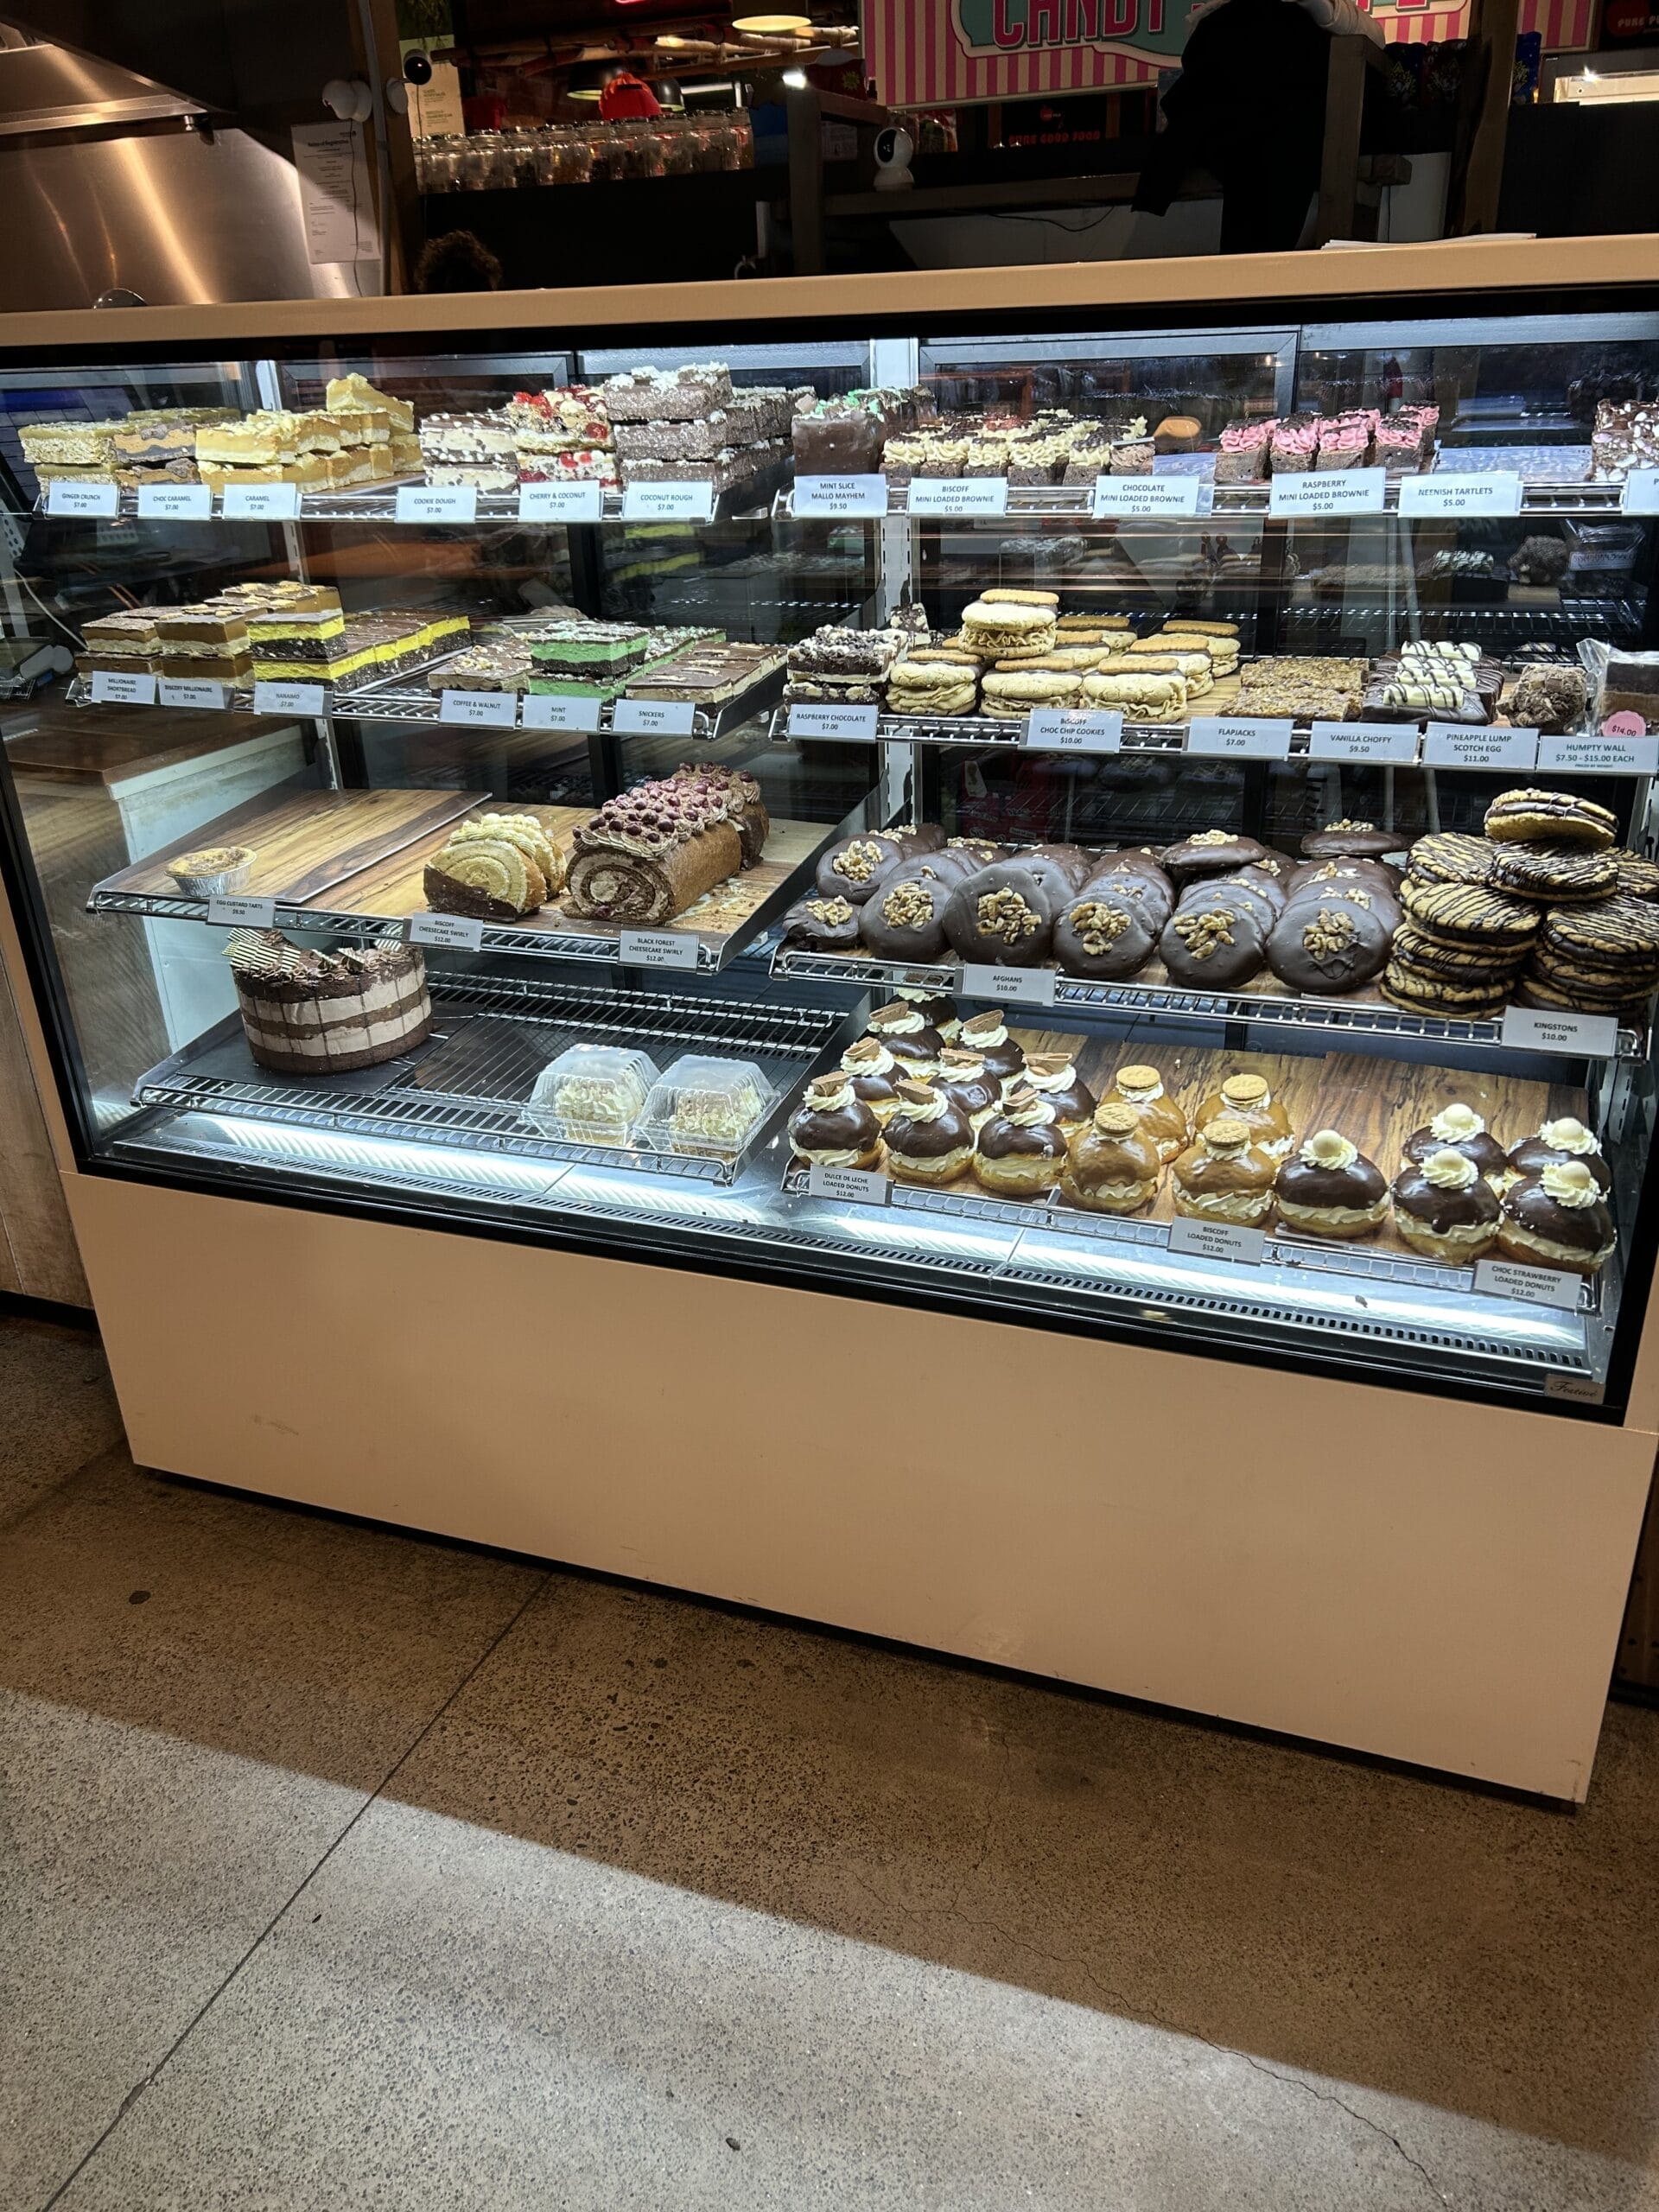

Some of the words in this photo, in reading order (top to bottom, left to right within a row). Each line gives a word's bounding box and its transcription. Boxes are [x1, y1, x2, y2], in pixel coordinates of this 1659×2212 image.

[1302, 480, 1346, 489] RASPBERRY
[1279, 493, 1297, 501] MINI
[1299, 491, 1330, 500] LOADED
[1332, 489, 1370, 499] BROWNIE
[1454, 486, 1493, 495] TARTLETS
[1313, 502, 1334, 511] $5.00
[1442, 499, 1465, 507] $5.00
[796, 713, 830, 721] RASPBERRY
[830, 714, 866, 722] CHOCOLATE
[1060, 717, 1087, 726] BISCOFF
[1040, 726, 1058, 734] CHOC
[1059, 727, 1075, 735] CHIP
[1076, 728, 1105, 736] COOKIES
[1218, 728, 1256, 737] FLAPJACKS
[1611, 725, 1637, 737] $14.00
[1059, 736, 1083, 745] $10.00
[1330, 734, 1362, 743] VANILLA
[1363, 735, 1392, 745] CHOFFY
[1446, 734, 1487, 742] PINEAPPLE
[1488, 734, 1512, 743] LUMP
[1349, 745, 1370, 753] $9.50
[1453, 744, 1484, 753] SCOTCH
[418, 926, 449, 935] CHEESECAKE
[629, 945, 662, 954] CHEESECAKE
[992, 975, 1023, 983] AFGHANS
[1534, 1022, 1579, 1033] KINGSTONS
[1541, 1033, 1567, 1041] $10.00
[824, 1173, 842, 1181] DULCE
[851, 1176, 868, 1185] LECHE
[823, 1180, 845, 1189] LOADED
[846, 1183, 869, 1192] DONUTS
[1203, 1226, 1230, 1236] BISCOFF
[1187, 1232, 1213, 1243] LOADED
[1214, 1237, 1242, 1248] DONUTS
[1202, 1243, 1224, 1253] $12.00
[1491, 1265, 1512, 1275] CHOC
[1513, 1269, 1562, 1284] STRAWBERRY
[1495, 1275, 1523, 1287] LOADED
[1524, 1281, 1555, 1292] DONUTS
[1511, 1287, 1535, 1298] $12.00
